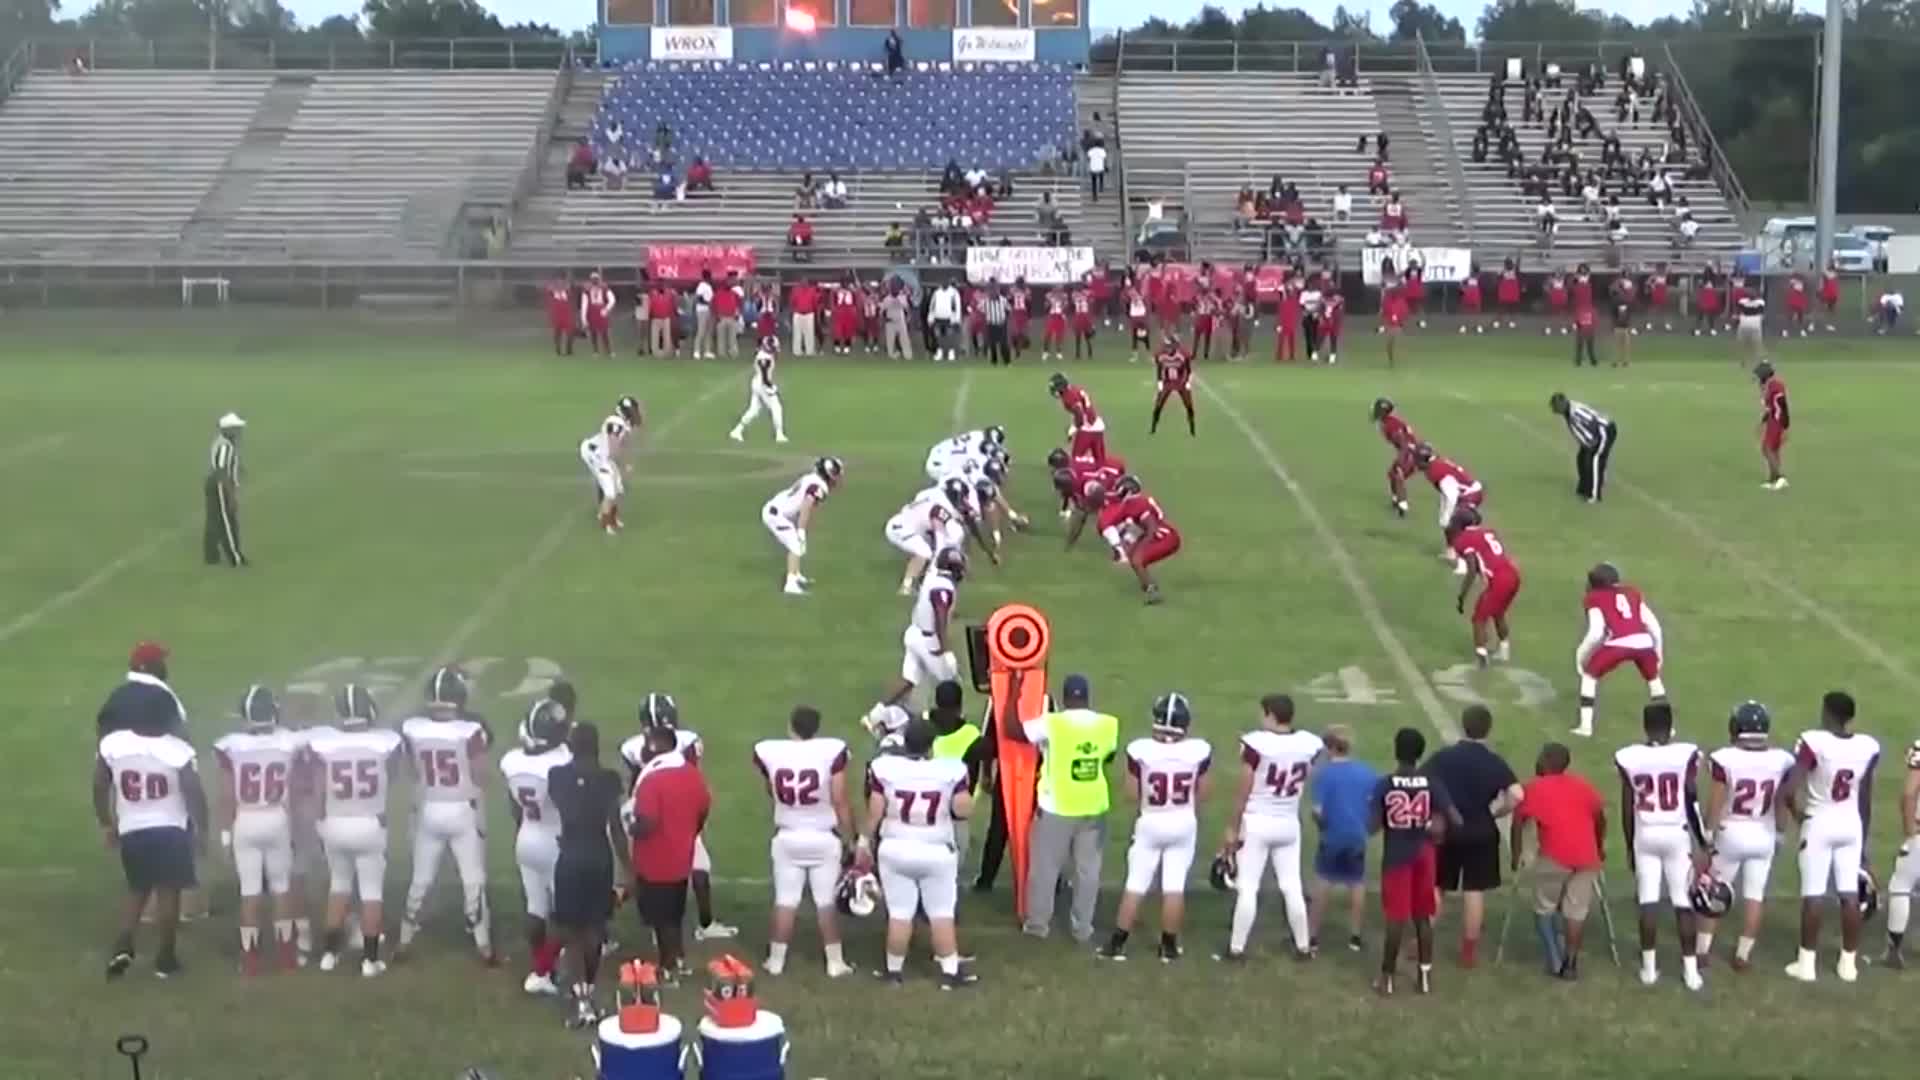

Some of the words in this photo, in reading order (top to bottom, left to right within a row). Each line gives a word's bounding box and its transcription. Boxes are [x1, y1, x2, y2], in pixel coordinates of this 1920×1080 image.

[664, 35, 717, 51] WROX
[1482, 532, 1503, 556] 6
[1614, 592, 1633, 620] 4
[238, 761, 287, 803] 66
[330, 759, 379, 800] 55
[419, 749, 460, 787] 15
[1265, 760, 1307, 798] 42
[1391, 774, 1429, 788] TYLER
[1831, 769, 1855, 802] 6
[774, 768, 820, 806] 62
[1147, 771, 1195, 806] 35
[1634, 771, 1680, 812] 20
[1731, 778, 1775, 815] 21
[895, 789, 942, 825] 77
[1384, 790, 1432, 828] 24
